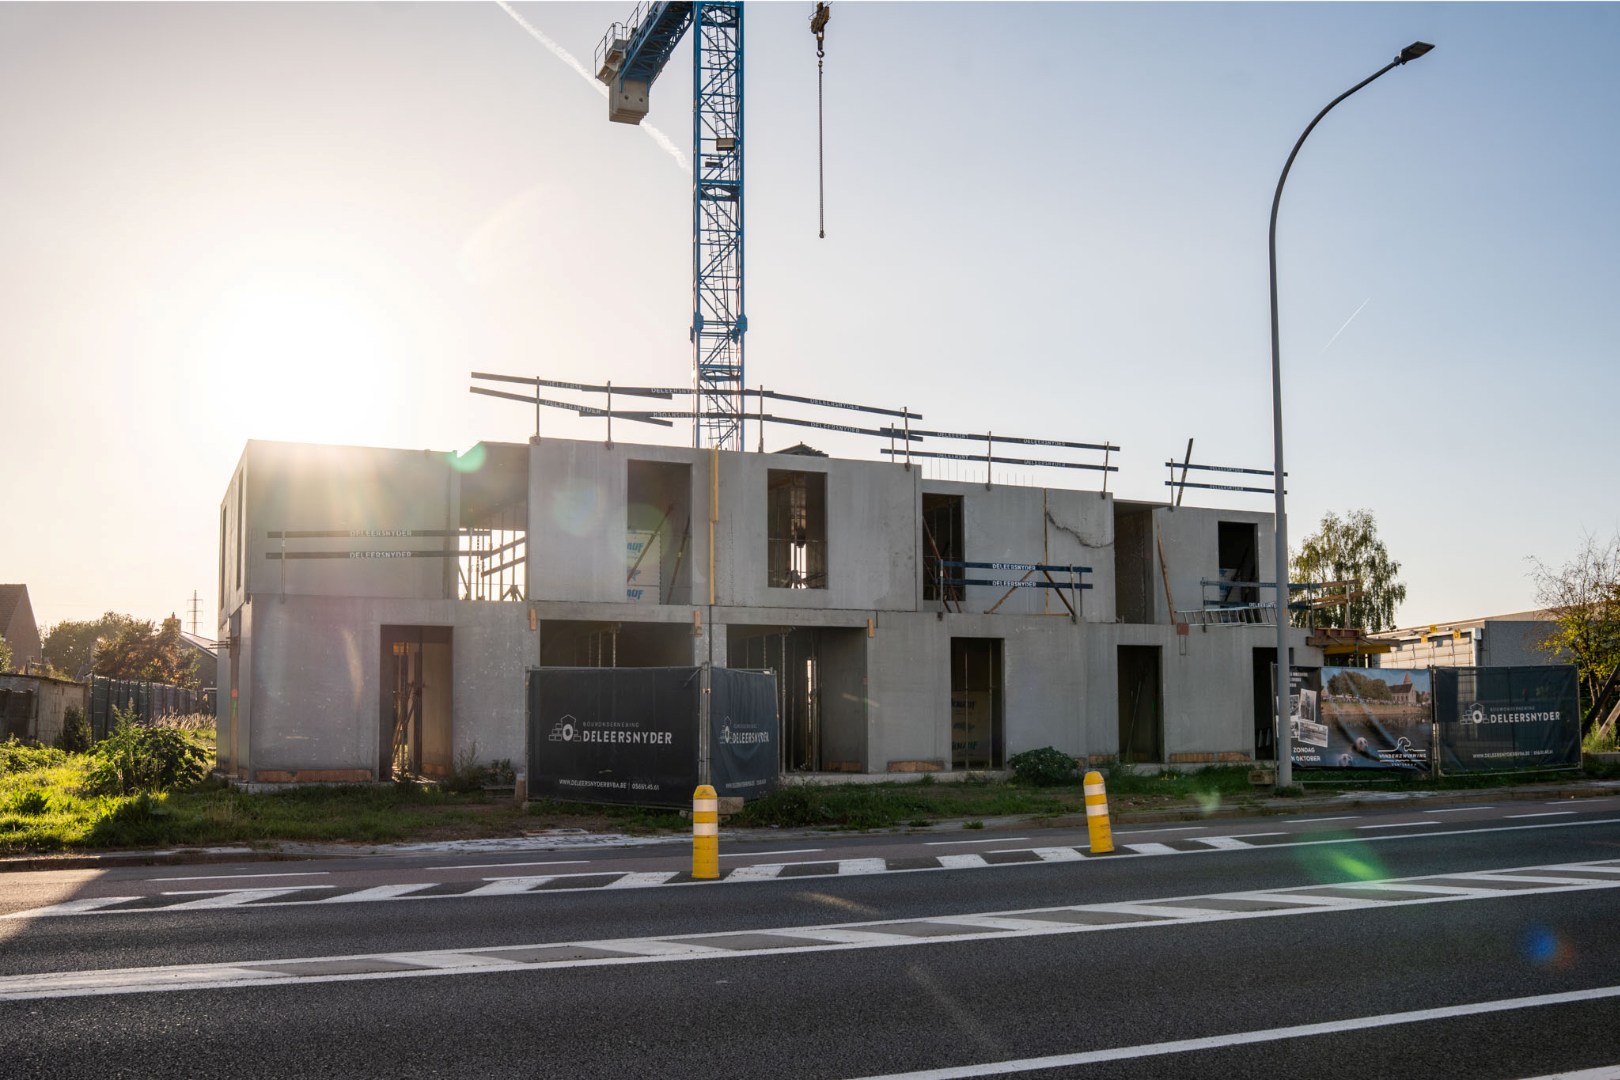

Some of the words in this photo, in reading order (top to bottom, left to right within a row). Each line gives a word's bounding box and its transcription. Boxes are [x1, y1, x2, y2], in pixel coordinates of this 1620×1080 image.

[350, 551, 411, 559] DELEERSNYDER
[1490, 711, 1560, 723] DELEERSNYDER
[583, 730, 672, 744] DELEERSNYDER
[732, 731, 769, 744] DELEERSNYDER
